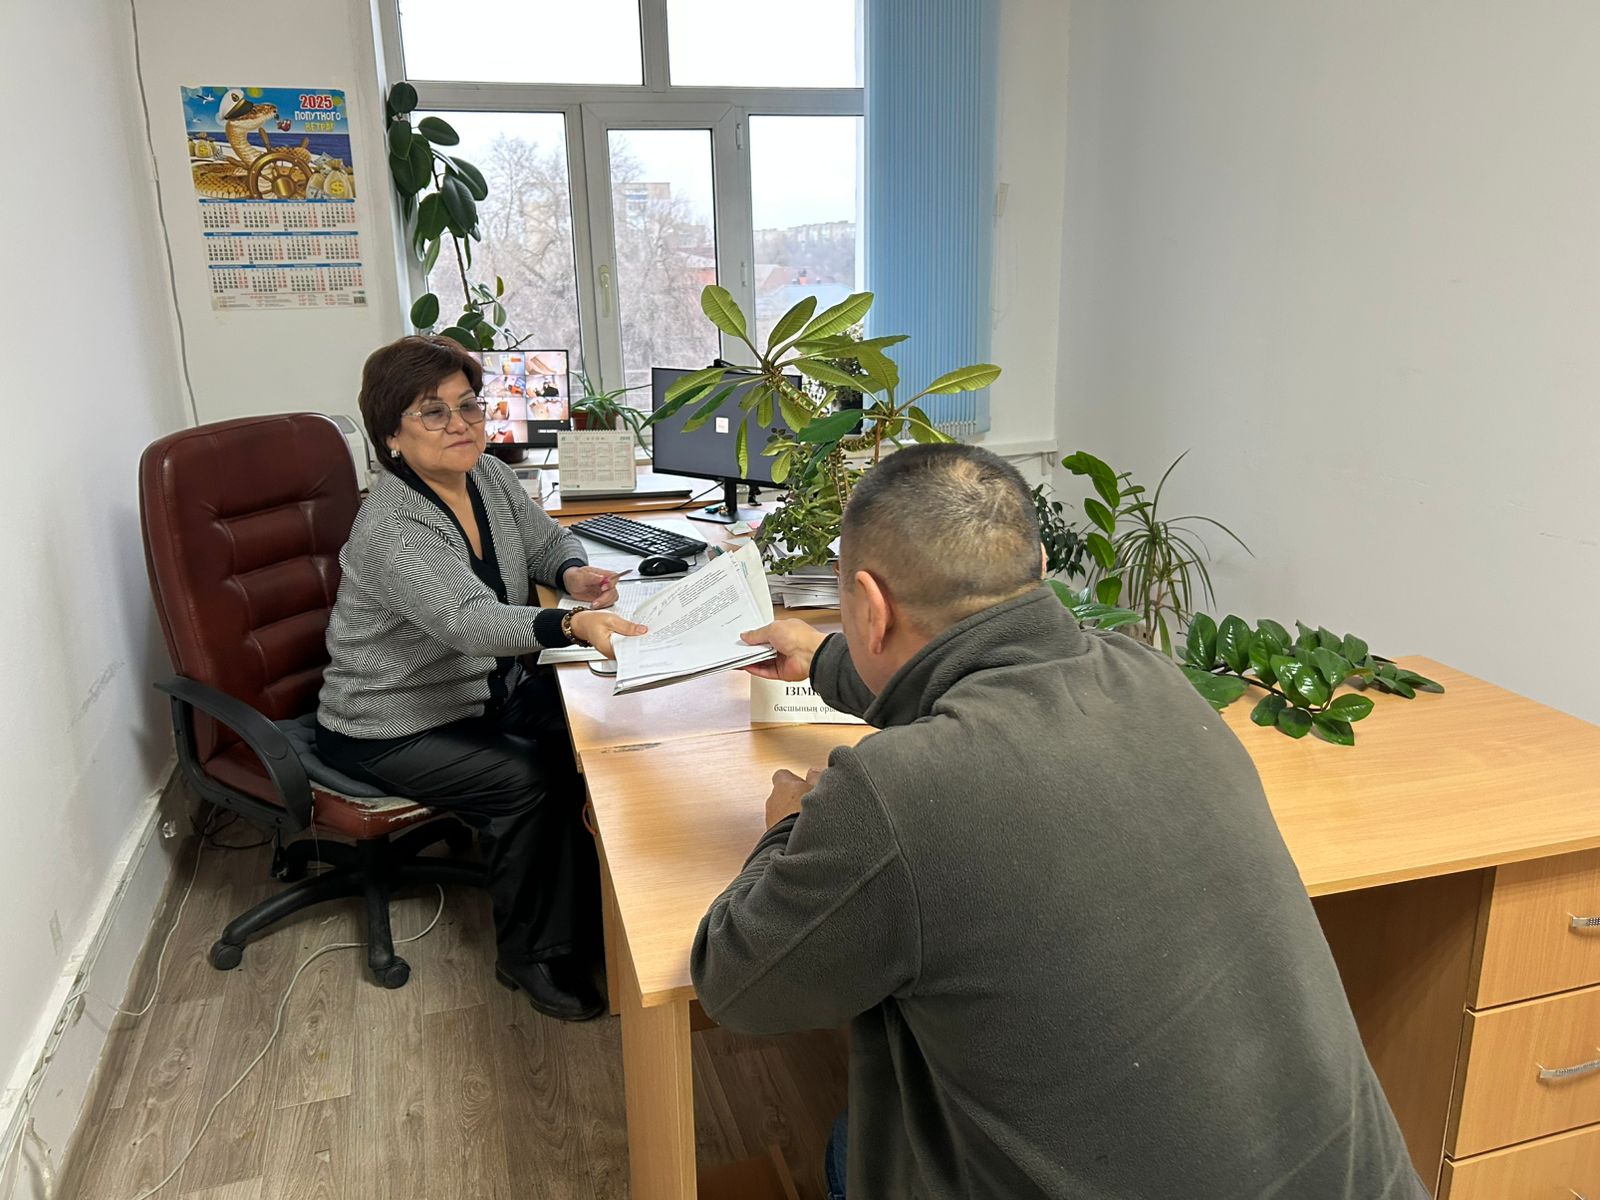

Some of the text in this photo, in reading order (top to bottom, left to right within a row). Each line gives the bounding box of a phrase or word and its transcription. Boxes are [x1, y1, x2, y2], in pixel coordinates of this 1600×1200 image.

[300, 95, 333, 109] 2025
[294, 110, 341, 121] ПОПУТНОГО
[774, 703, 818, 713] басшының
